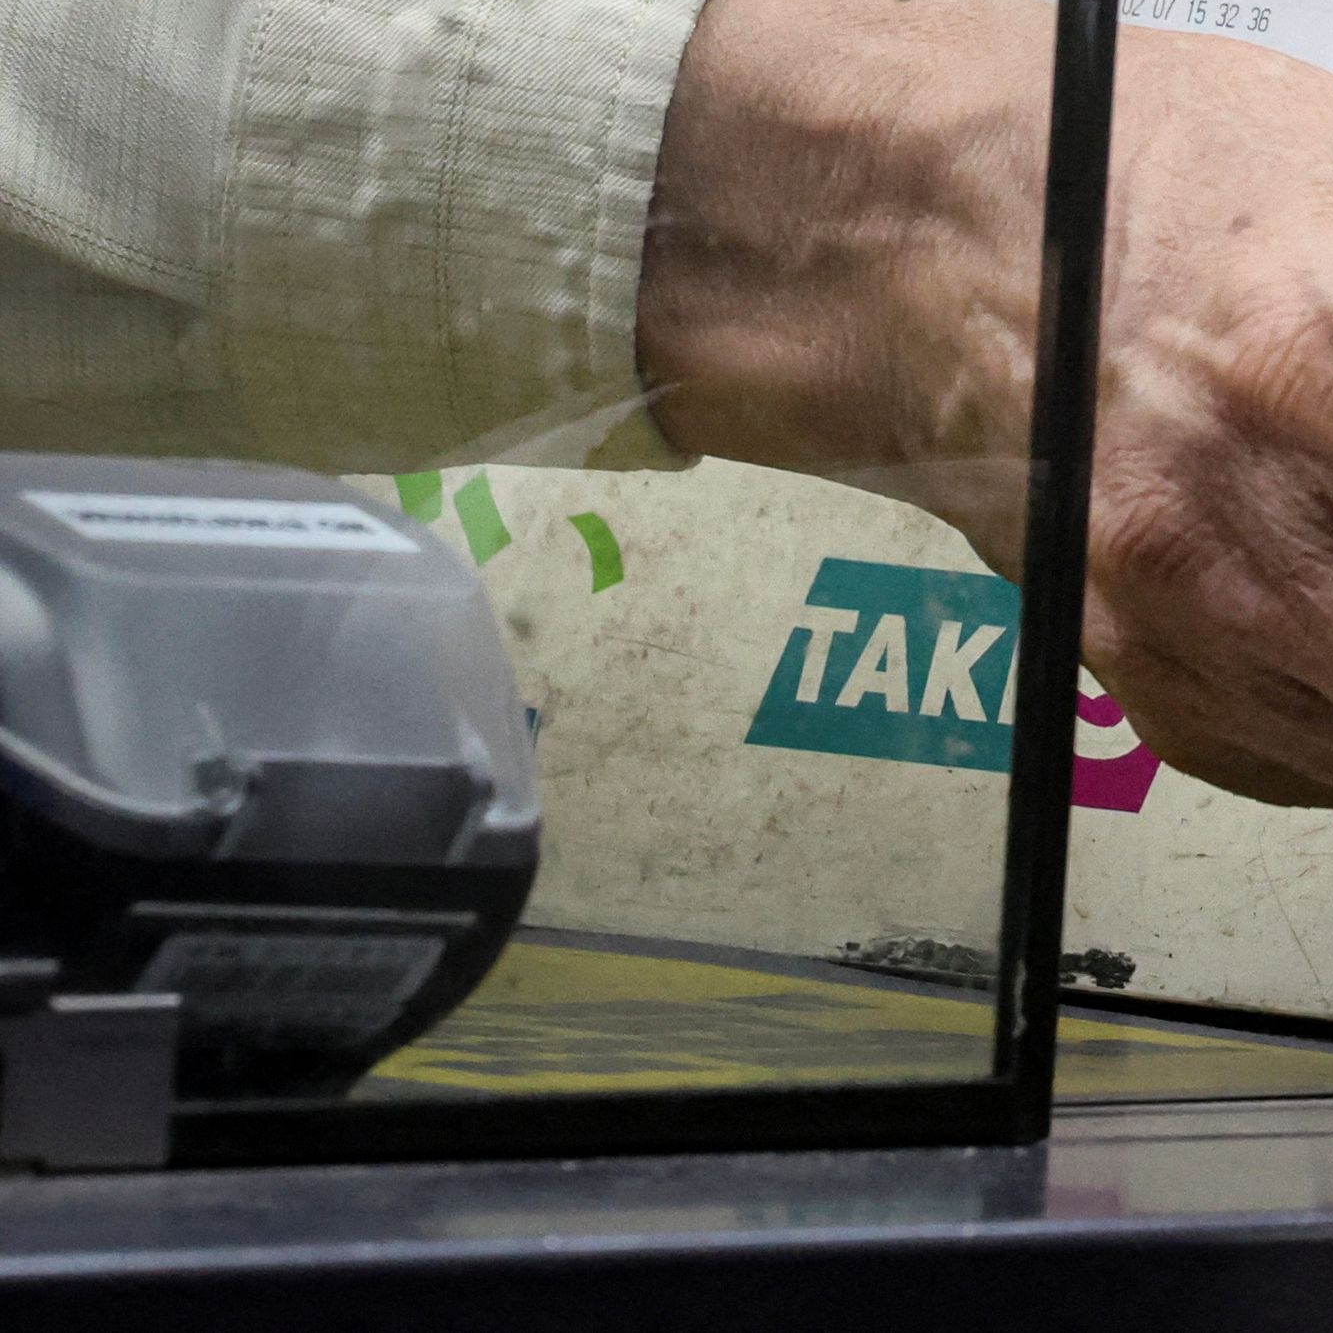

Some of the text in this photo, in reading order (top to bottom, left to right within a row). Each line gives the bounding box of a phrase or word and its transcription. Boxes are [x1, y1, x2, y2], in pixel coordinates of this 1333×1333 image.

[1187, 0, 1207, 25] 15
[1215, 3, 1240, 29] 32
[1247, 7, 1272, 33] 36
[789, 603, 1016, 726] TAK
